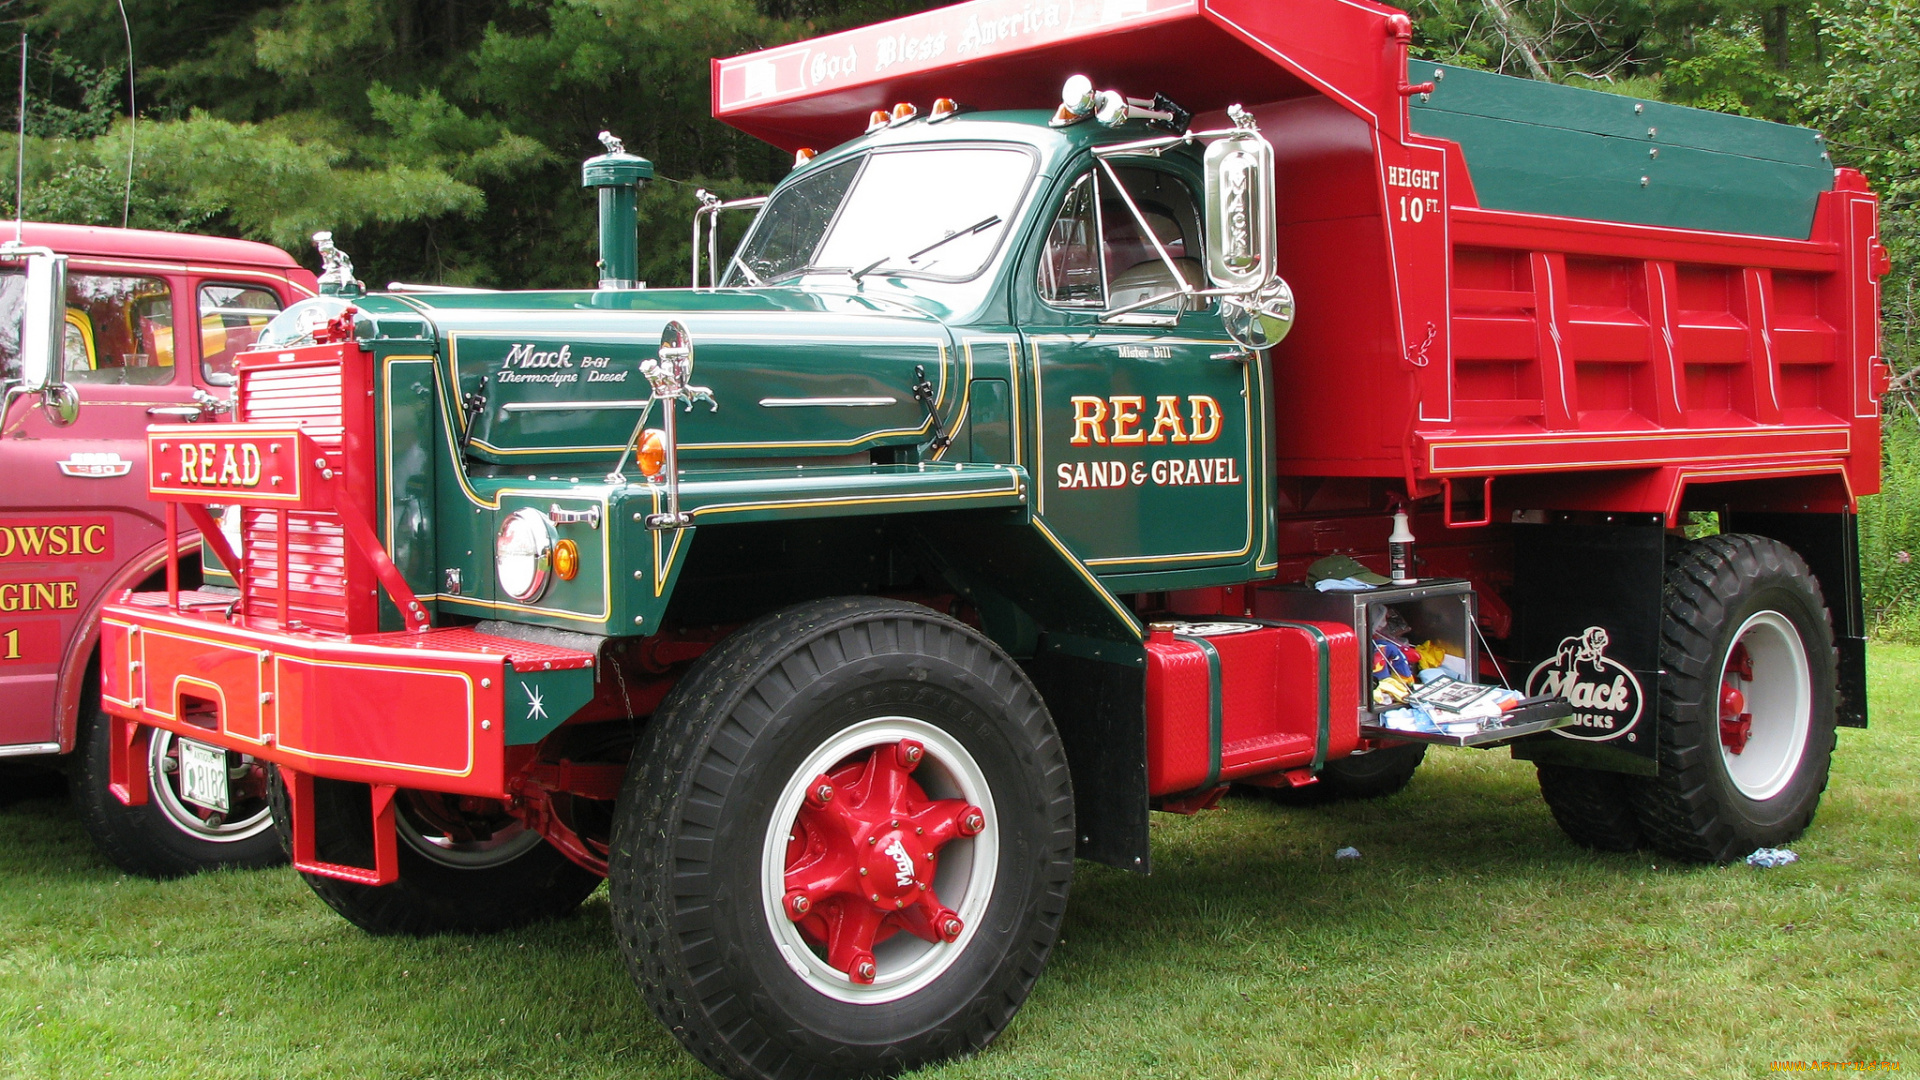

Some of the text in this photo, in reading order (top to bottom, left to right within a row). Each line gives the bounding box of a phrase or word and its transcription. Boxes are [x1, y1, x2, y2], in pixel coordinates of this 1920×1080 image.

[809, 2, 1061, 86] God Bless America
[1388, 166, 1439, 190] HEIGHT
[1400, 197, 1440, 223] 10 FT.
[502, 343, 573, 369] Mack
[1118, 346, 1171, 358] Mister Bill
[497, 370, 628, 388] Thermodyne Diesel
[1070, 395, 1224, 446] READ
[179, 442, 262, 487] READ
[1057, 457, 1242, 490] SAND & GRAVEL
[0, 581, 78, 611] GINE
[3, 628, 22, 659] 1
[1539, 670, 1628, 711] Mack
[1573, 713, 1614, 729] UCKS
[885, 840, 914, 887] Mack
